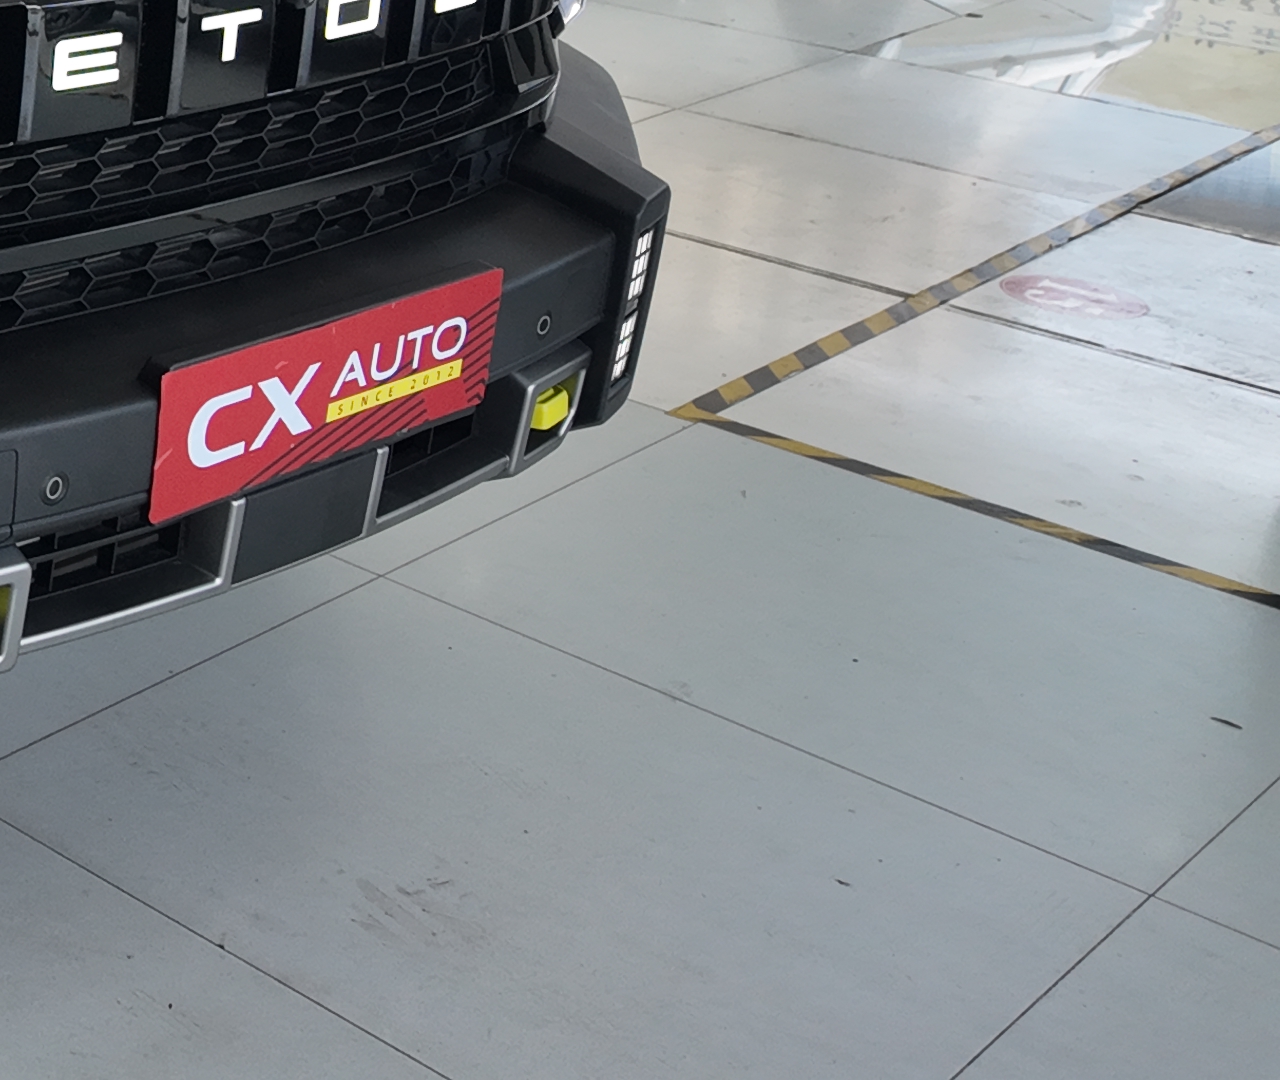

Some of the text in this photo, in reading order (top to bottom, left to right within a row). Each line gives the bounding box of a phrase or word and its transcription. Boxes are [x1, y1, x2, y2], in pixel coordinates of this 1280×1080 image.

[186, 316, 468, 468] CX AUTO
[336, 365, 456, 417] SINCE 2012
